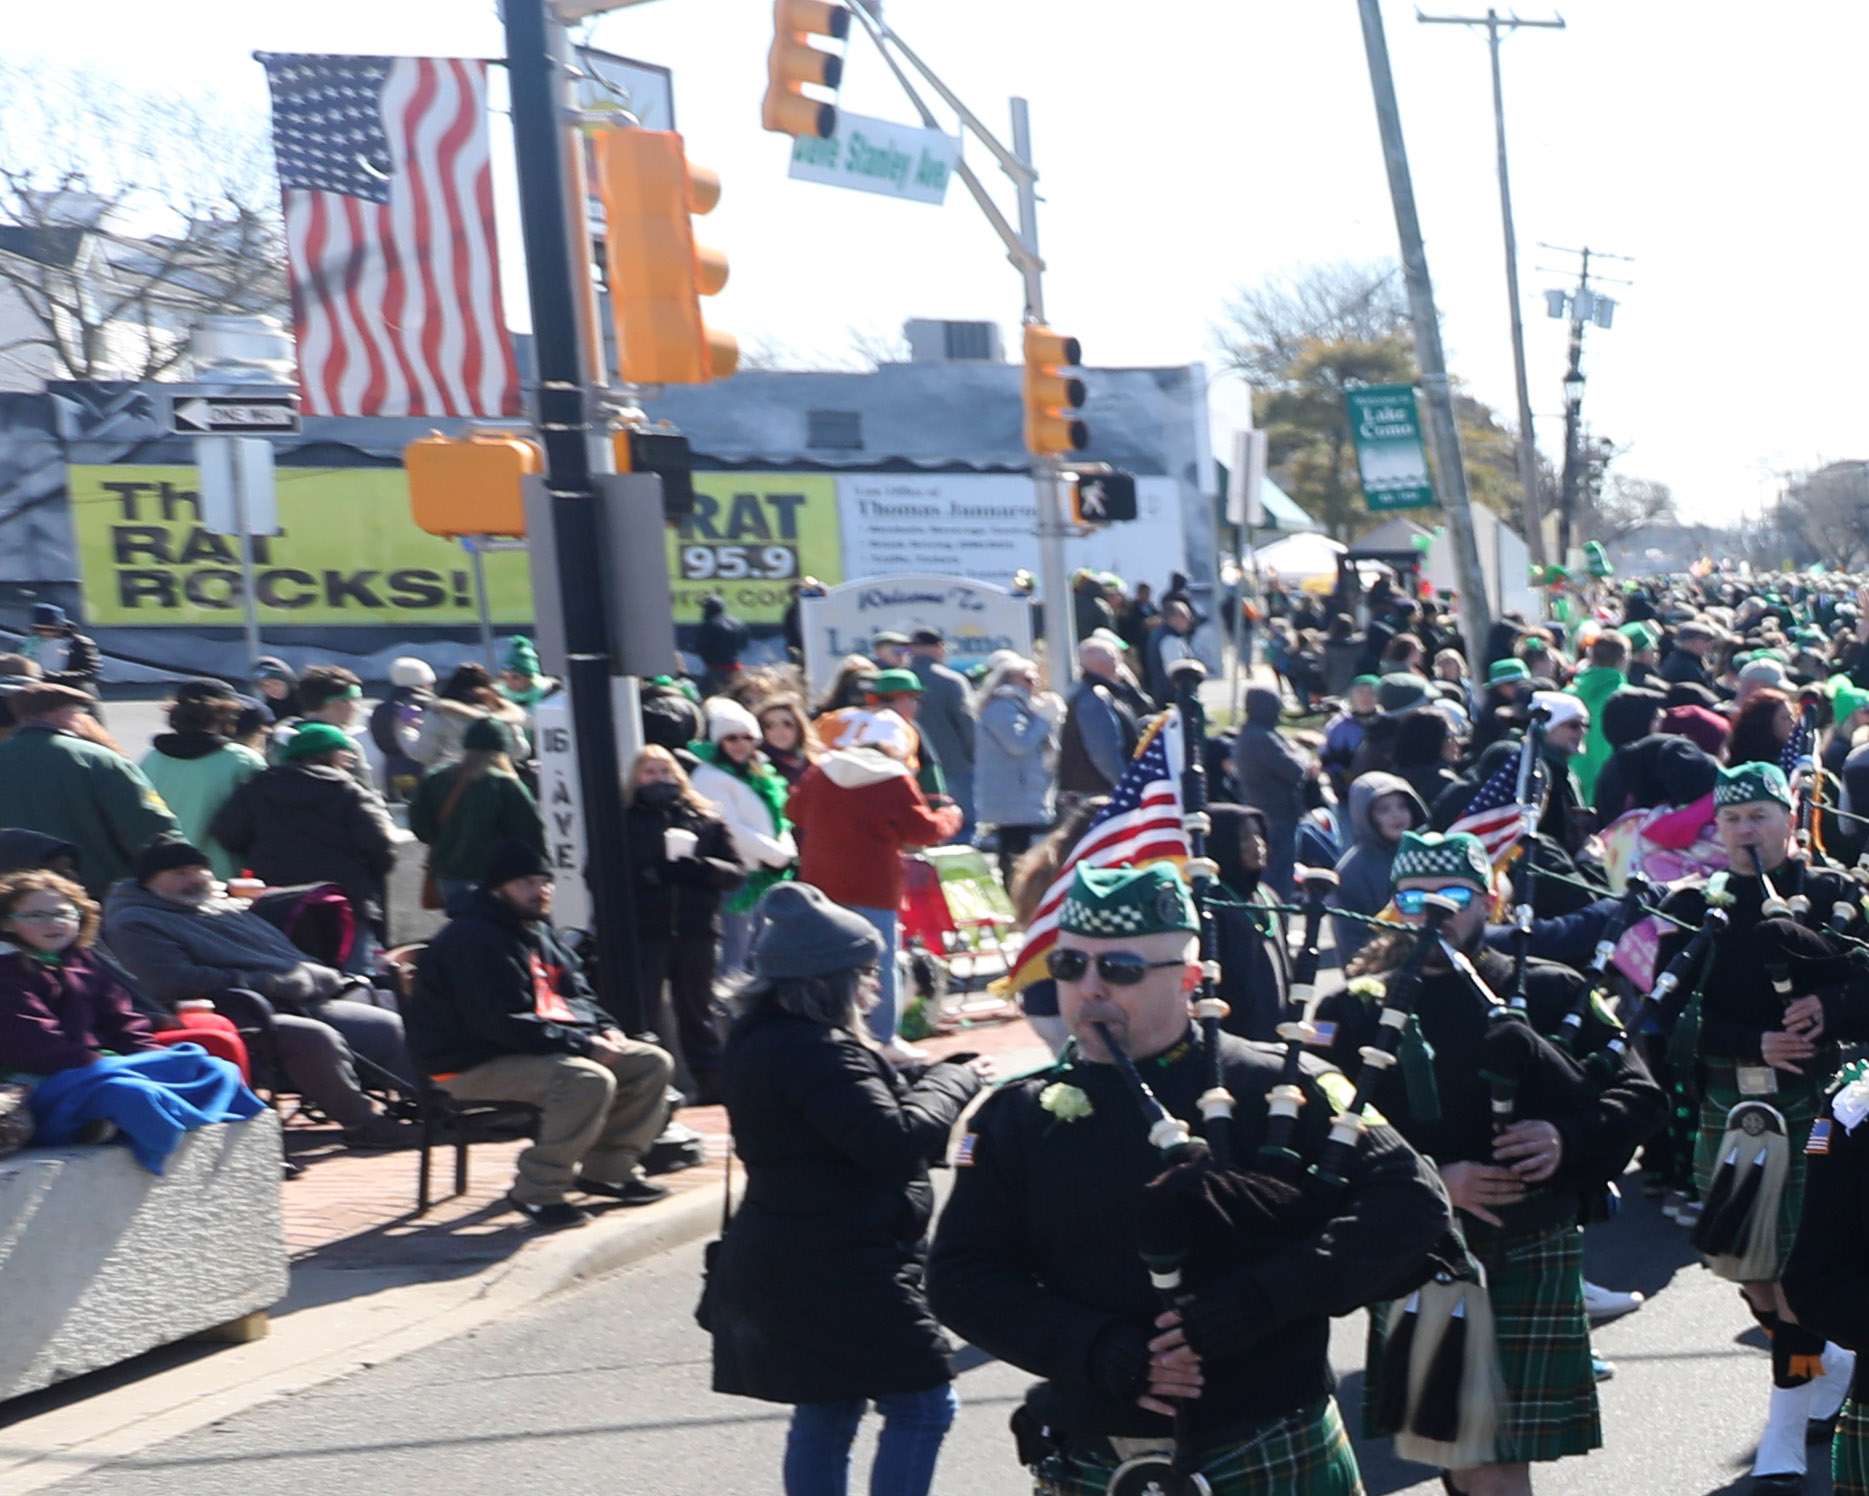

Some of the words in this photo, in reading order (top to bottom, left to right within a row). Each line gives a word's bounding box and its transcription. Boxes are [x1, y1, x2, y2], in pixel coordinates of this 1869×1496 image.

[845, 129, 913, 191] Stanley
[99, 480, 204, 521] Th
[678, 491, 808, 540] RAT
[682, 546, 797, 580] 95.9
[117, 568, 472, 609] ROCKS!
